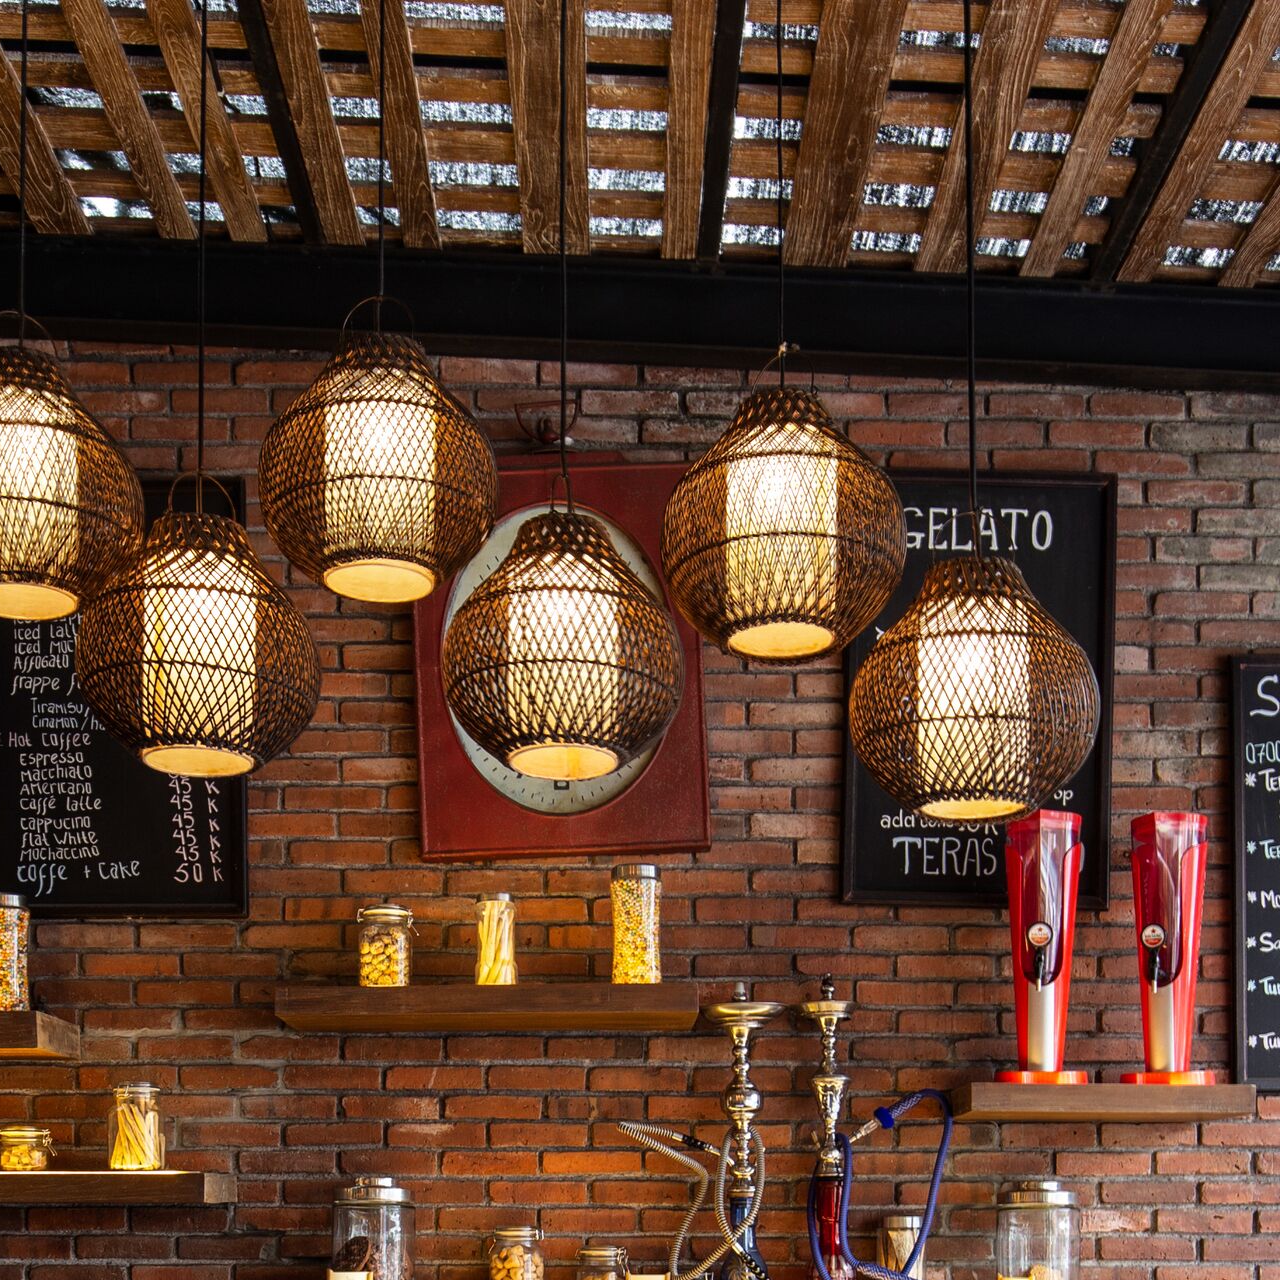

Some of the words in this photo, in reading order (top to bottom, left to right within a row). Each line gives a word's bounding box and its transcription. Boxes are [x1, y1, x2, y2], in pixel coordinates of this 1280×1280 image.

[901, 507, 1053, 552] GELATO
[11, 675, 60, 696] frappe
[9, 732, 32, 748] Hot
[20, 752, 83, 768] Espresso
[21, 763, 92, 782] Macchiato
[20, 782, 92, 795] Americano
[169, 779, 192, 794] 45
[66, 796, 102, 811] latte
[22, 832, 50, 848] flat
[20, 845, 100, 862] Mochaccino
[893, 836, 997, 876] TERAS
[174, 863, 202, 882] 50
